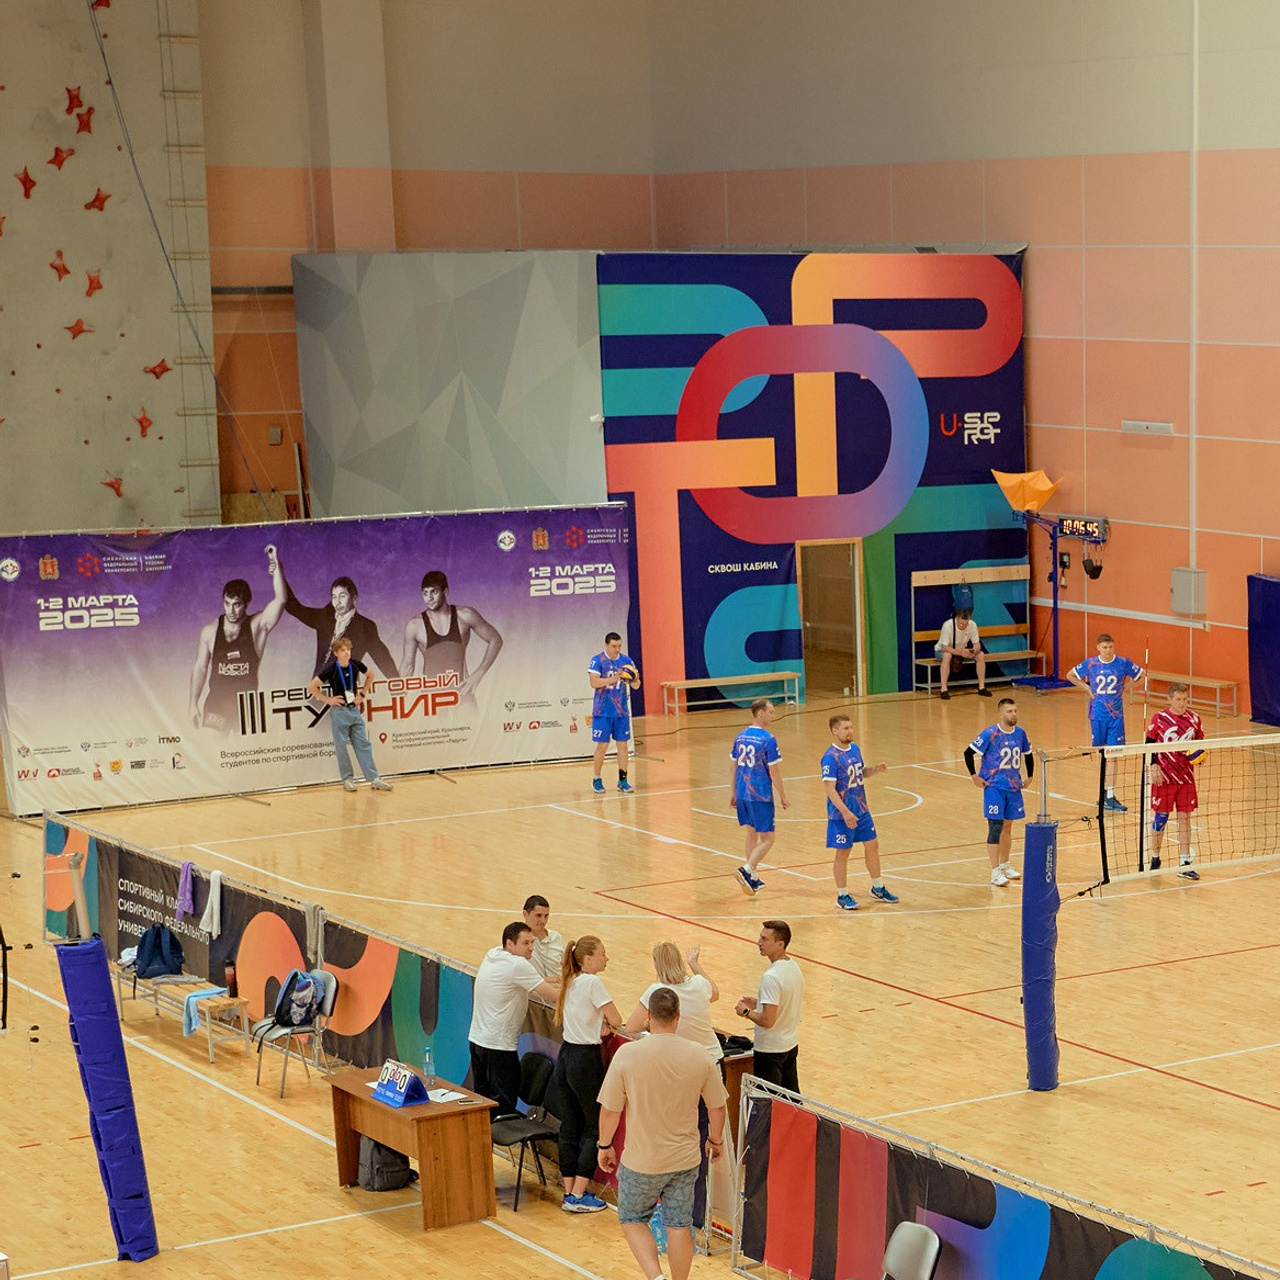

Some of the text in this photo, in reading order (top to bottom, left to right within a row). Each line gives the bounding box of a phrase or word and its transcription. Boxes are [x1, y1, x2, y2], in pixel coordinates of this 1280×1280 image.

[528, 563, 616, 577] 1-2 МАРТА
[707, 561, 778, 573] СКВОШ КАБИНА
[529, 575, 616, 597] 2025
[37, 594, 139, 610] 1-2 МАРТА
[39, 607, 140, 631] 2025
[1096, 675, 1117, 694] 22
[593, 730, 602, 738] 27
[220, 745, 281, 759] Всероссийские
[220, 756, 261, 769] студентов
[261, 756, 271, 764] по
[272, 750, 318, 763] спортивной
[738, 744, 755, 767] 23
[1000, 747, 1021, 769] 28
[847, 762, 865, 788] 25
[988, 805, 999, 814] 28
[835, 834, 847, 843] 25
[118, 878, 164, 905] СПОРТИВНЫЙ
[118, 898, 163, 923] СИБИРСКОГО
[399, 1074, 407, 1090] 0
